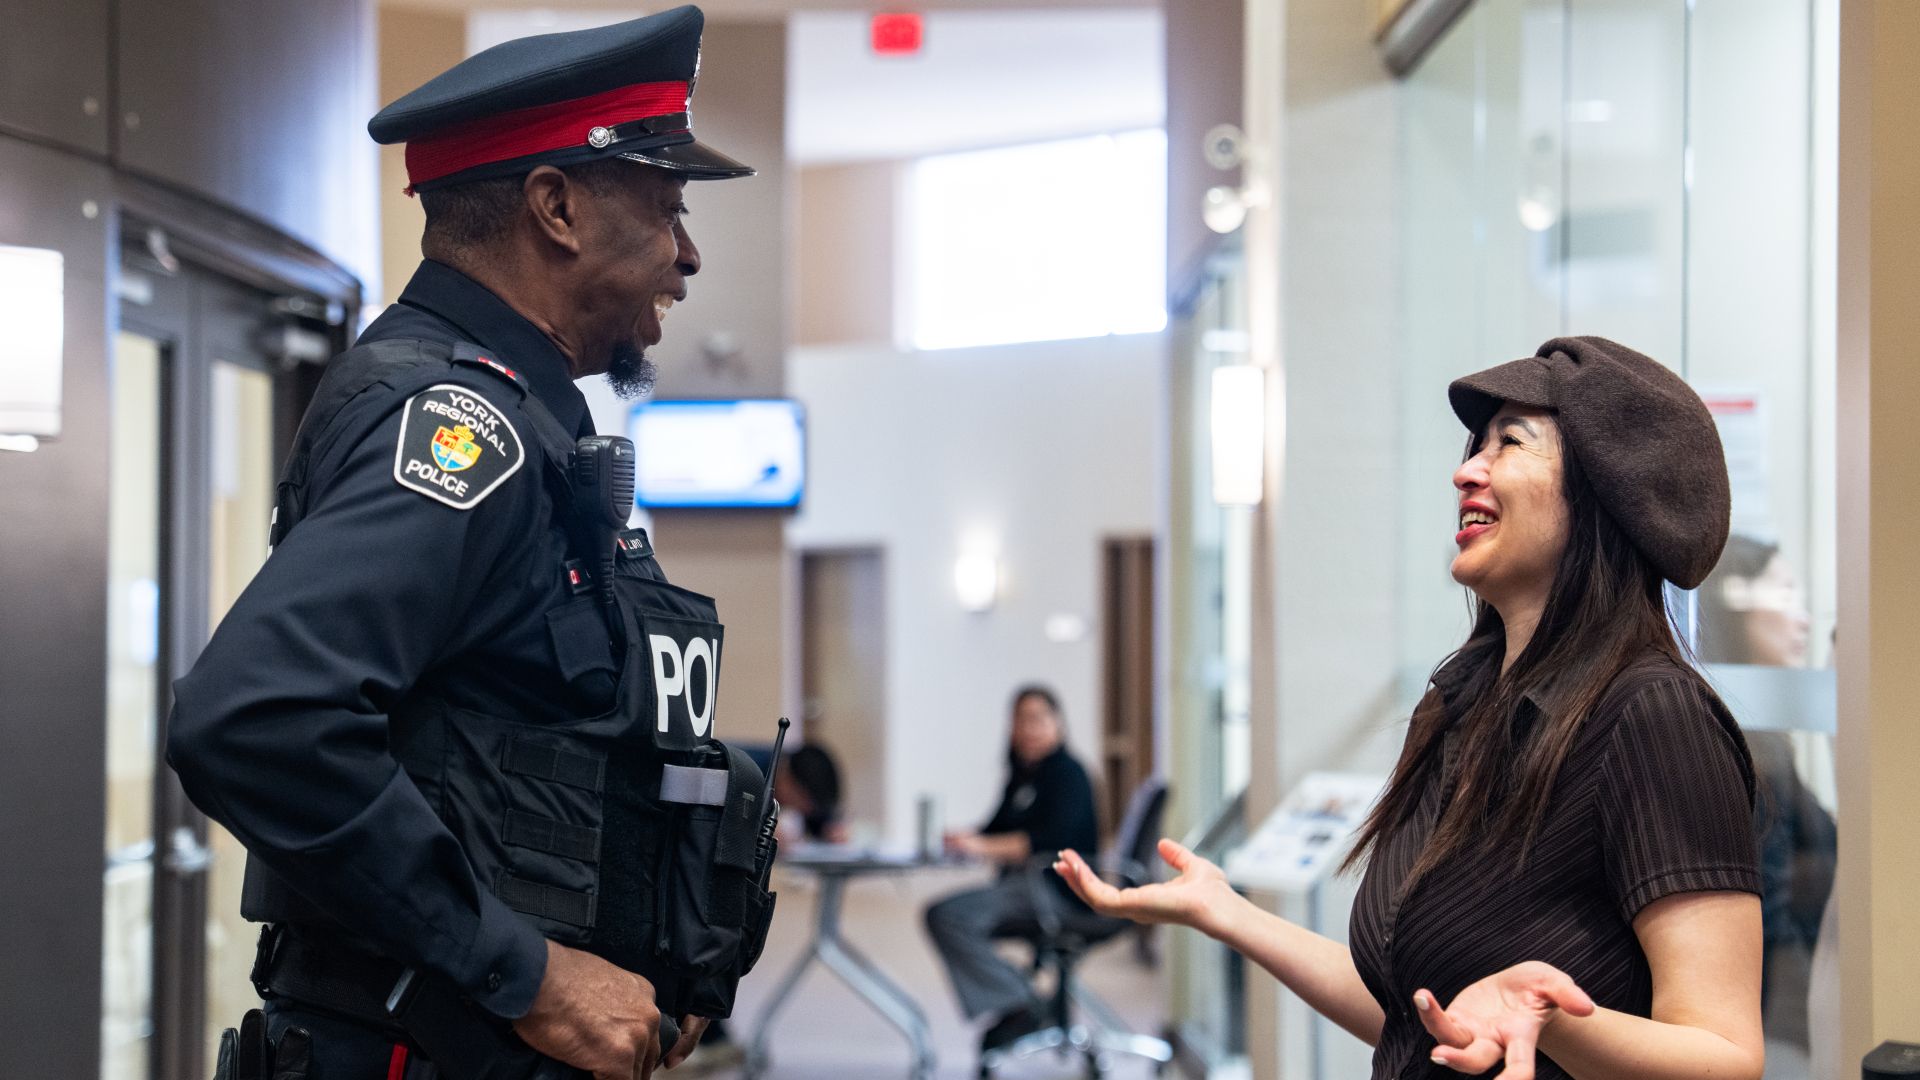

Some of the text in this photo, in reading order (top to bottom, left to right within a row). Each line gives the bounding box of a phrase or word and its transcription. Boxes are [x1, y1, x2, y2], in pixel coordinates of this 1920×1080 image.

[423, 400, 506, 457] REGIONAL
[449, 392, 500, 431] YORK
[405, 459, 469, 497] POLICE
